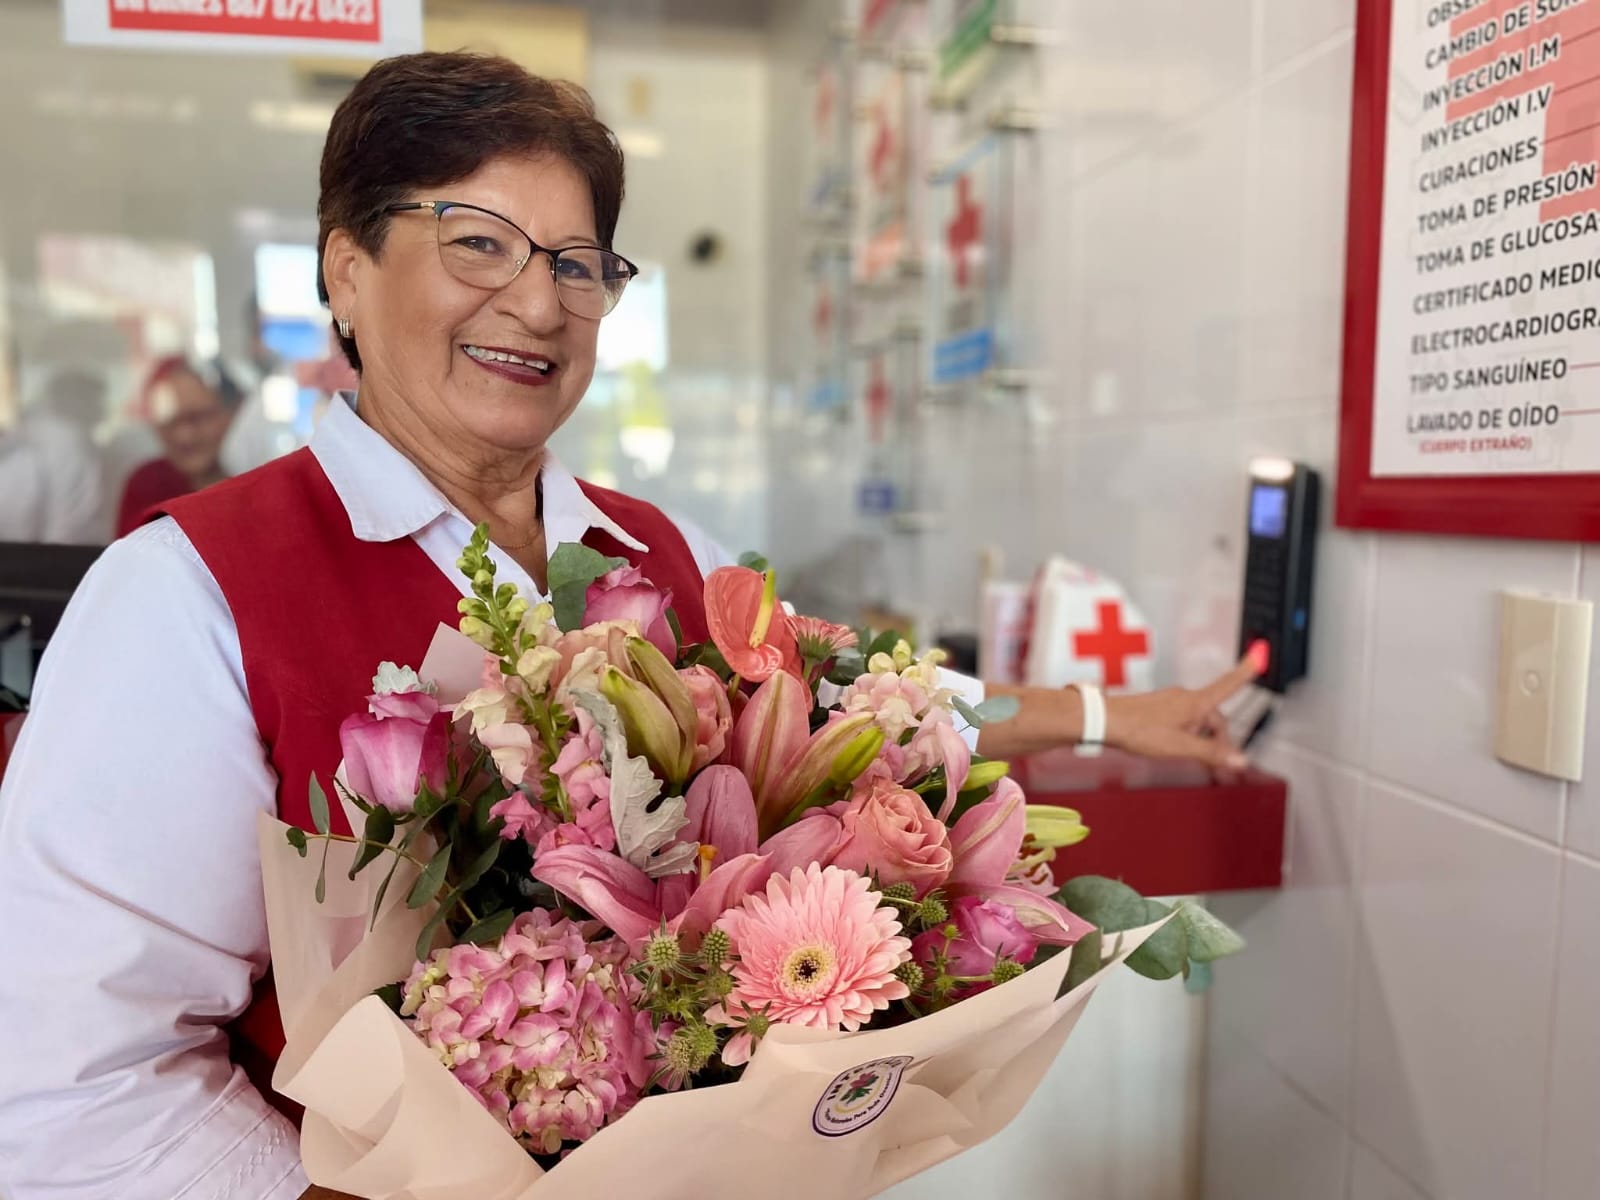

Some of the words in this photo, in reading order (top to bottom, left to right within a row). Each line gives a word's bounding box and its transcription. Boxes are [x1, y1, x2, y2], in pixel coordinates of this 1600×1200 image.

[1425, 21, 1497, 70] CAMBIO
[1504, 6, 1530, 34] DE
[1529, 37, 1559, 68] I.M
[1527, 86, 1552, 115] I.V
[1419, 137, 1539, 193] CURACIONES
[1417, 203, 1467, 234] TOMA
[1472, 195, 1498, 219] DE
[1503, 164, 1596, 210] PRESIÓN
[1415, 246, 1465, 275] TOMA
[1470, 238, 1495, 261] DE
[1501, 212, 1599, 253] GLUCOSA
[1412, 272, 1533, 315] CERTIFICADO
[1411, 307, 1600, 355] ELECTROCARDIOGR
[1409, 372, 1449, 394] TIPO
[1453, 357, 1568, 390] SANGUÍNEO
[1407, 410, 1473, 434] LAVADO
[1477, 409, 1502, 430] DE
[1508, 402, 1560, 428] OÍDO
[1470, 434, 1533, 452] EXTRAÑO)
